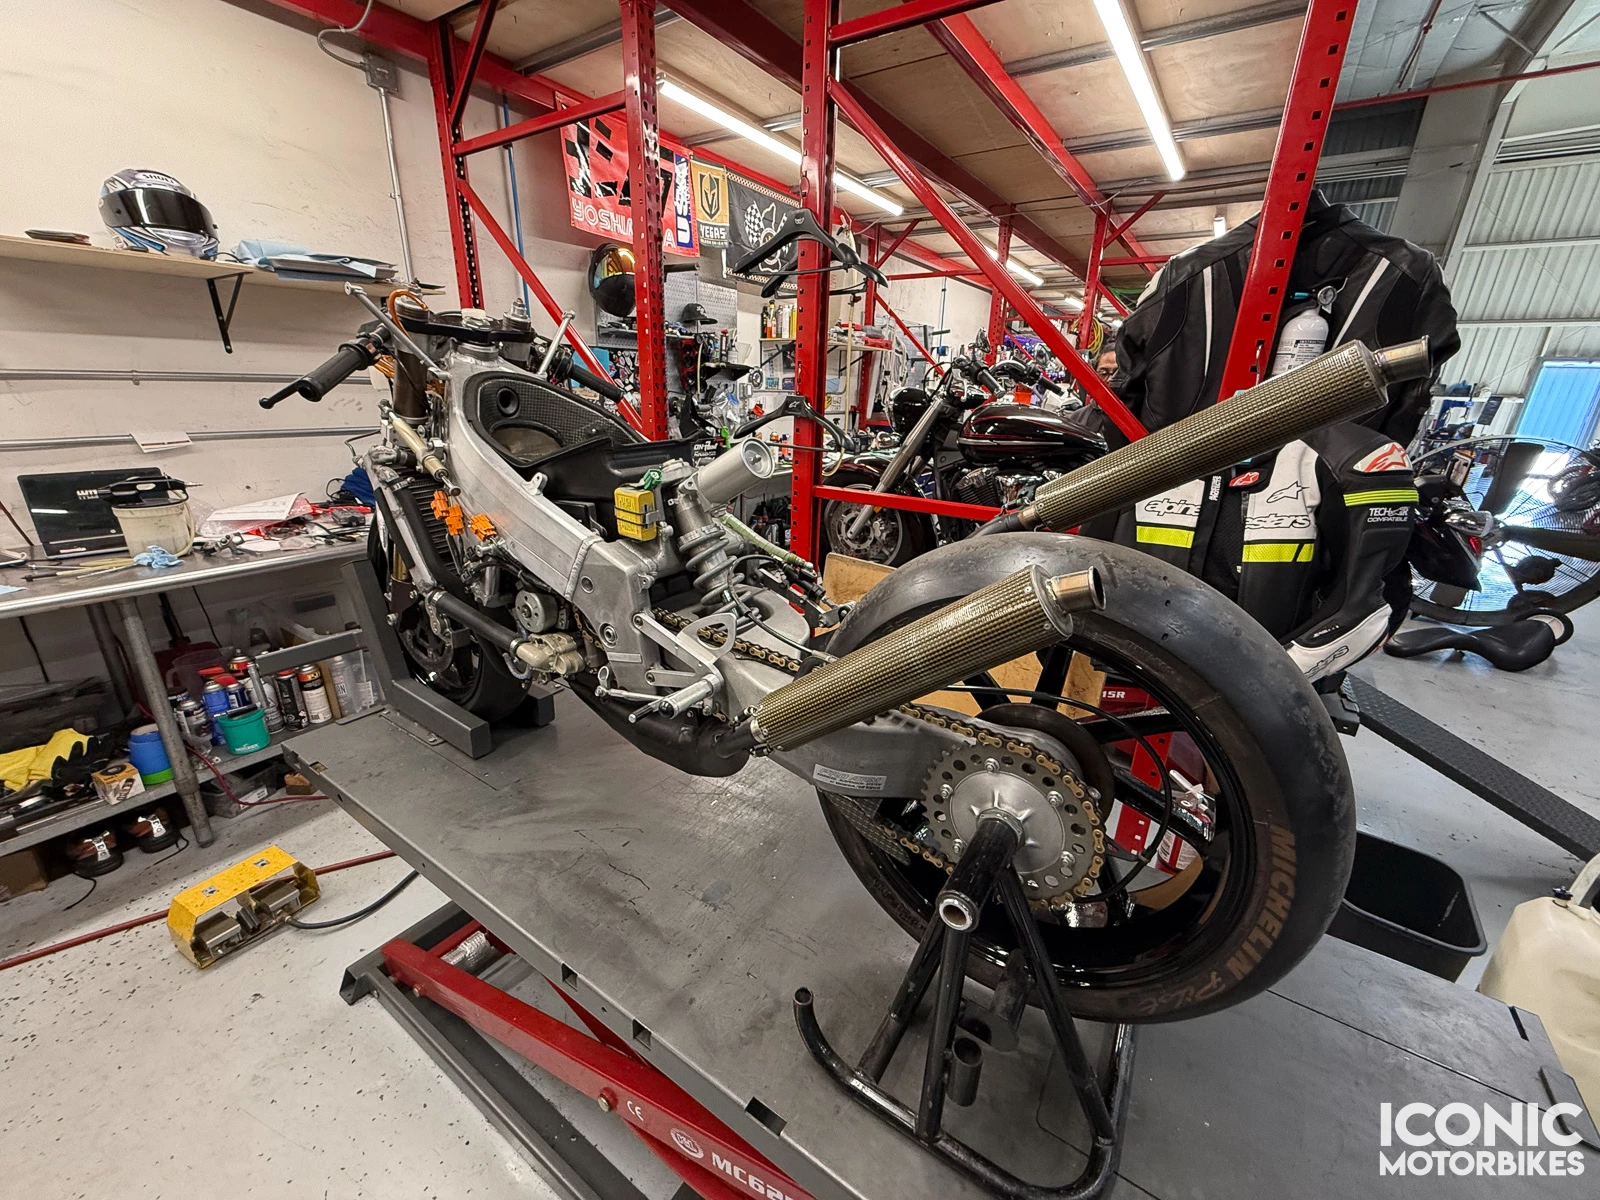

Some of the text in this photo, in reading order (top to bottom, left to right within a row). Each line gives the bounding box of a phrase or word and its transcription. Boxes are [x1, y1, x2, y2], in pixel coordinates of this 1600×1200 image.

[700, 224, 727, 240] VEGAS
[1226, 825, 1296, 981] MICHELIN
[711, 1151, 798, 1200] MC62
